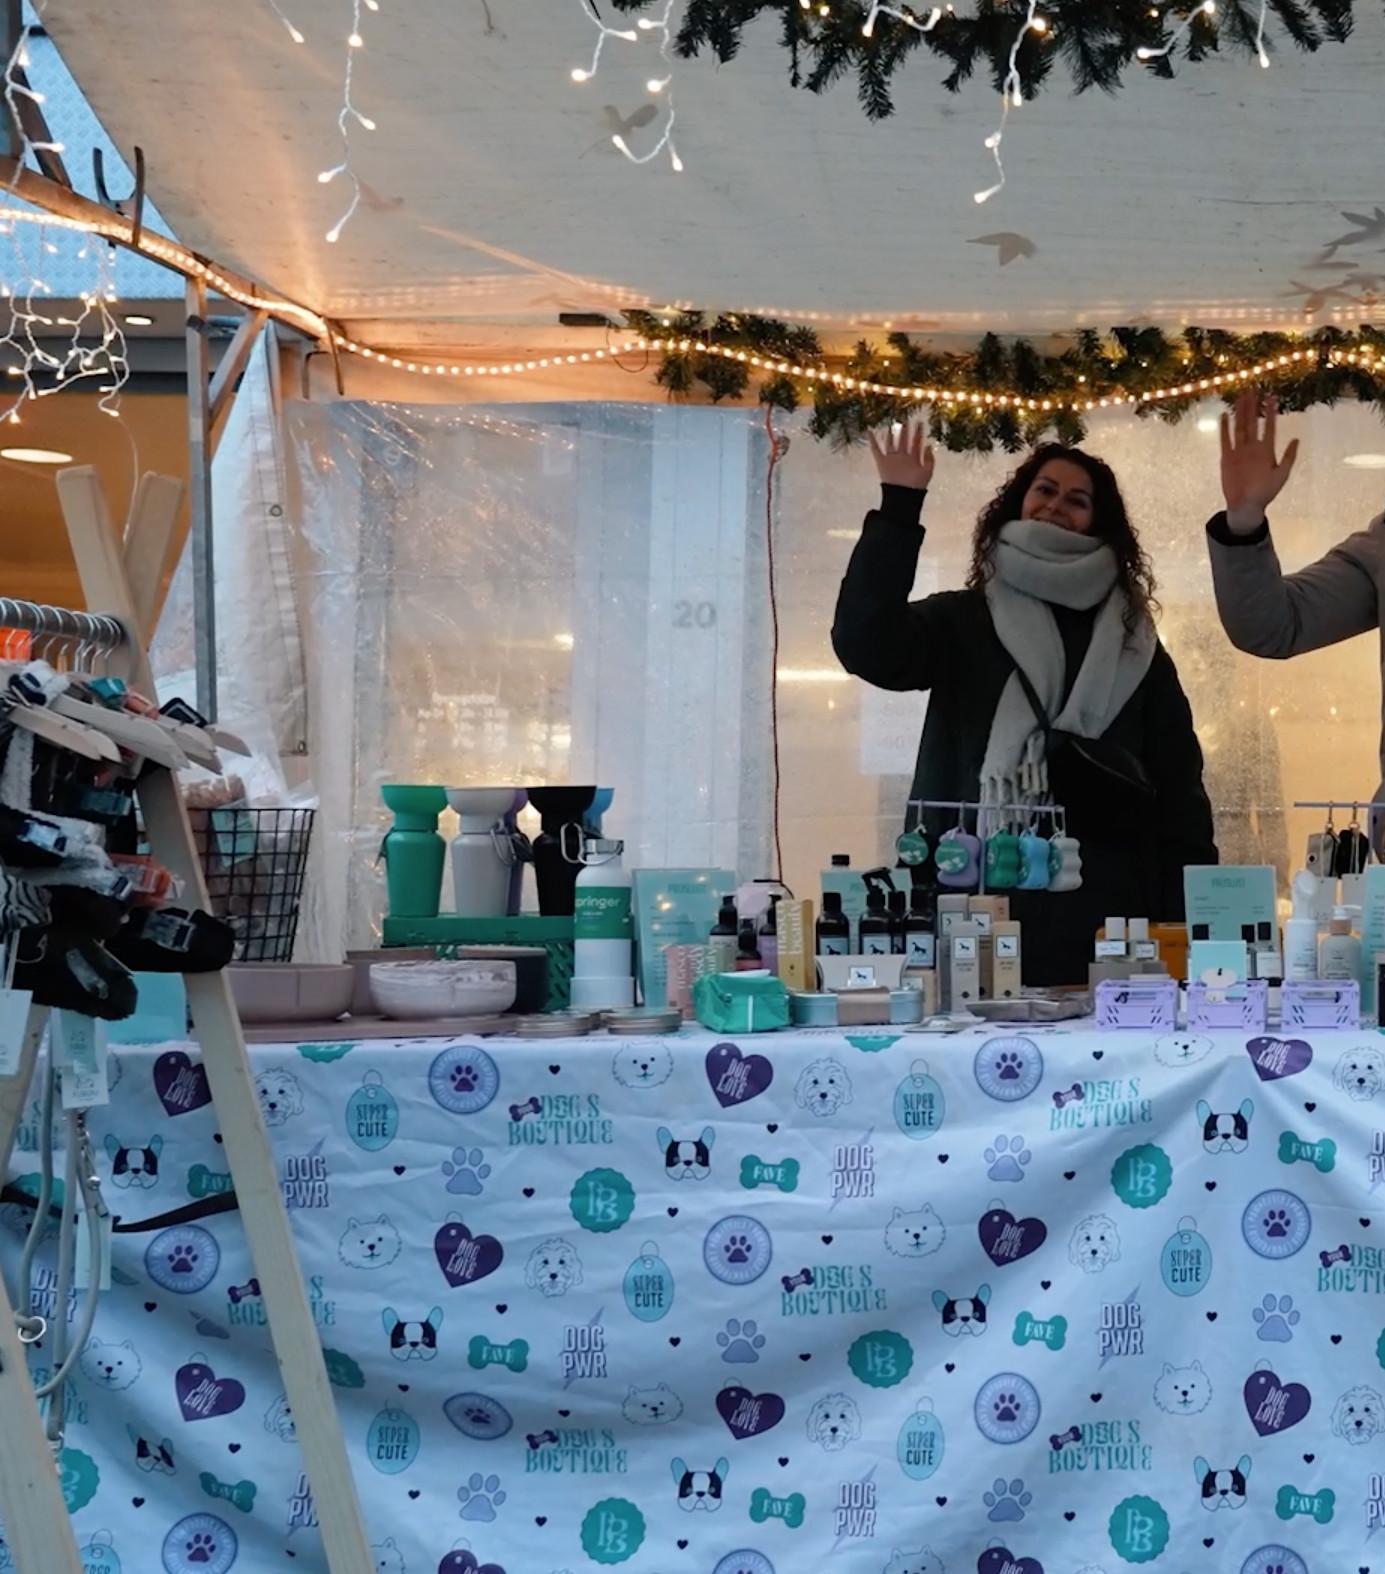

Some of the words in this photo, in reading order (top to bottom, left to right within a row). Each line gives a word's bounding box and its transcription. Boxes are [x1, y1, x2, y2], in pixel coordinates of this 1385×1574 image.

[671, 600, 717, 628] 20
[904, 1109, 934, 1127] CUTE
[1049, 1100, 1152, 1132] BOUTIQUE
[356, 1121, 388, 1138] CUTE
[507, 1120, 613, 1146] BOUTIQUE
[834, 1145, 874, 1170] DOG
[1292, 1144, 1323, 1160] FAVE
[285, 1157, 326, 1182] DOG
[753, 1166, 785, 1182] FAVE
[284, 1180, 329, 1208] PWR
[832, 1169, 875, 1198] PWR
[1171, 1265, 1202, 1282] CUTE
[633, 1292, 664, 1309] CUTE
[781, 1287, 888, 1318] BOUTIQUE
[1102, 1303, 1140, 1328] DOG
[563, 1326, 604, 1352] DOG
[1024, 1323, 1055, 1340] FAVE
[1099, 1327, 1144, 1356] PWR
[482, 1346, 515, 1362] FAVE
[562, 1351, 607, 1378] PWR
[377, 1444, 409, 1460] CUTE
[525, 1448, 628, 1473] BOUTIQUE
[906, 1446, 935, 1466] CUTE
[1048, 1445, 1152, 1474] BOUTIQUE
[838, 1482, 876, 1508] DOG
[1291, 1494, 1321, 1511] FAVE
[762, 1500, 792, 1517] FAVE
[835, 1507, 876, 1537] PWR
